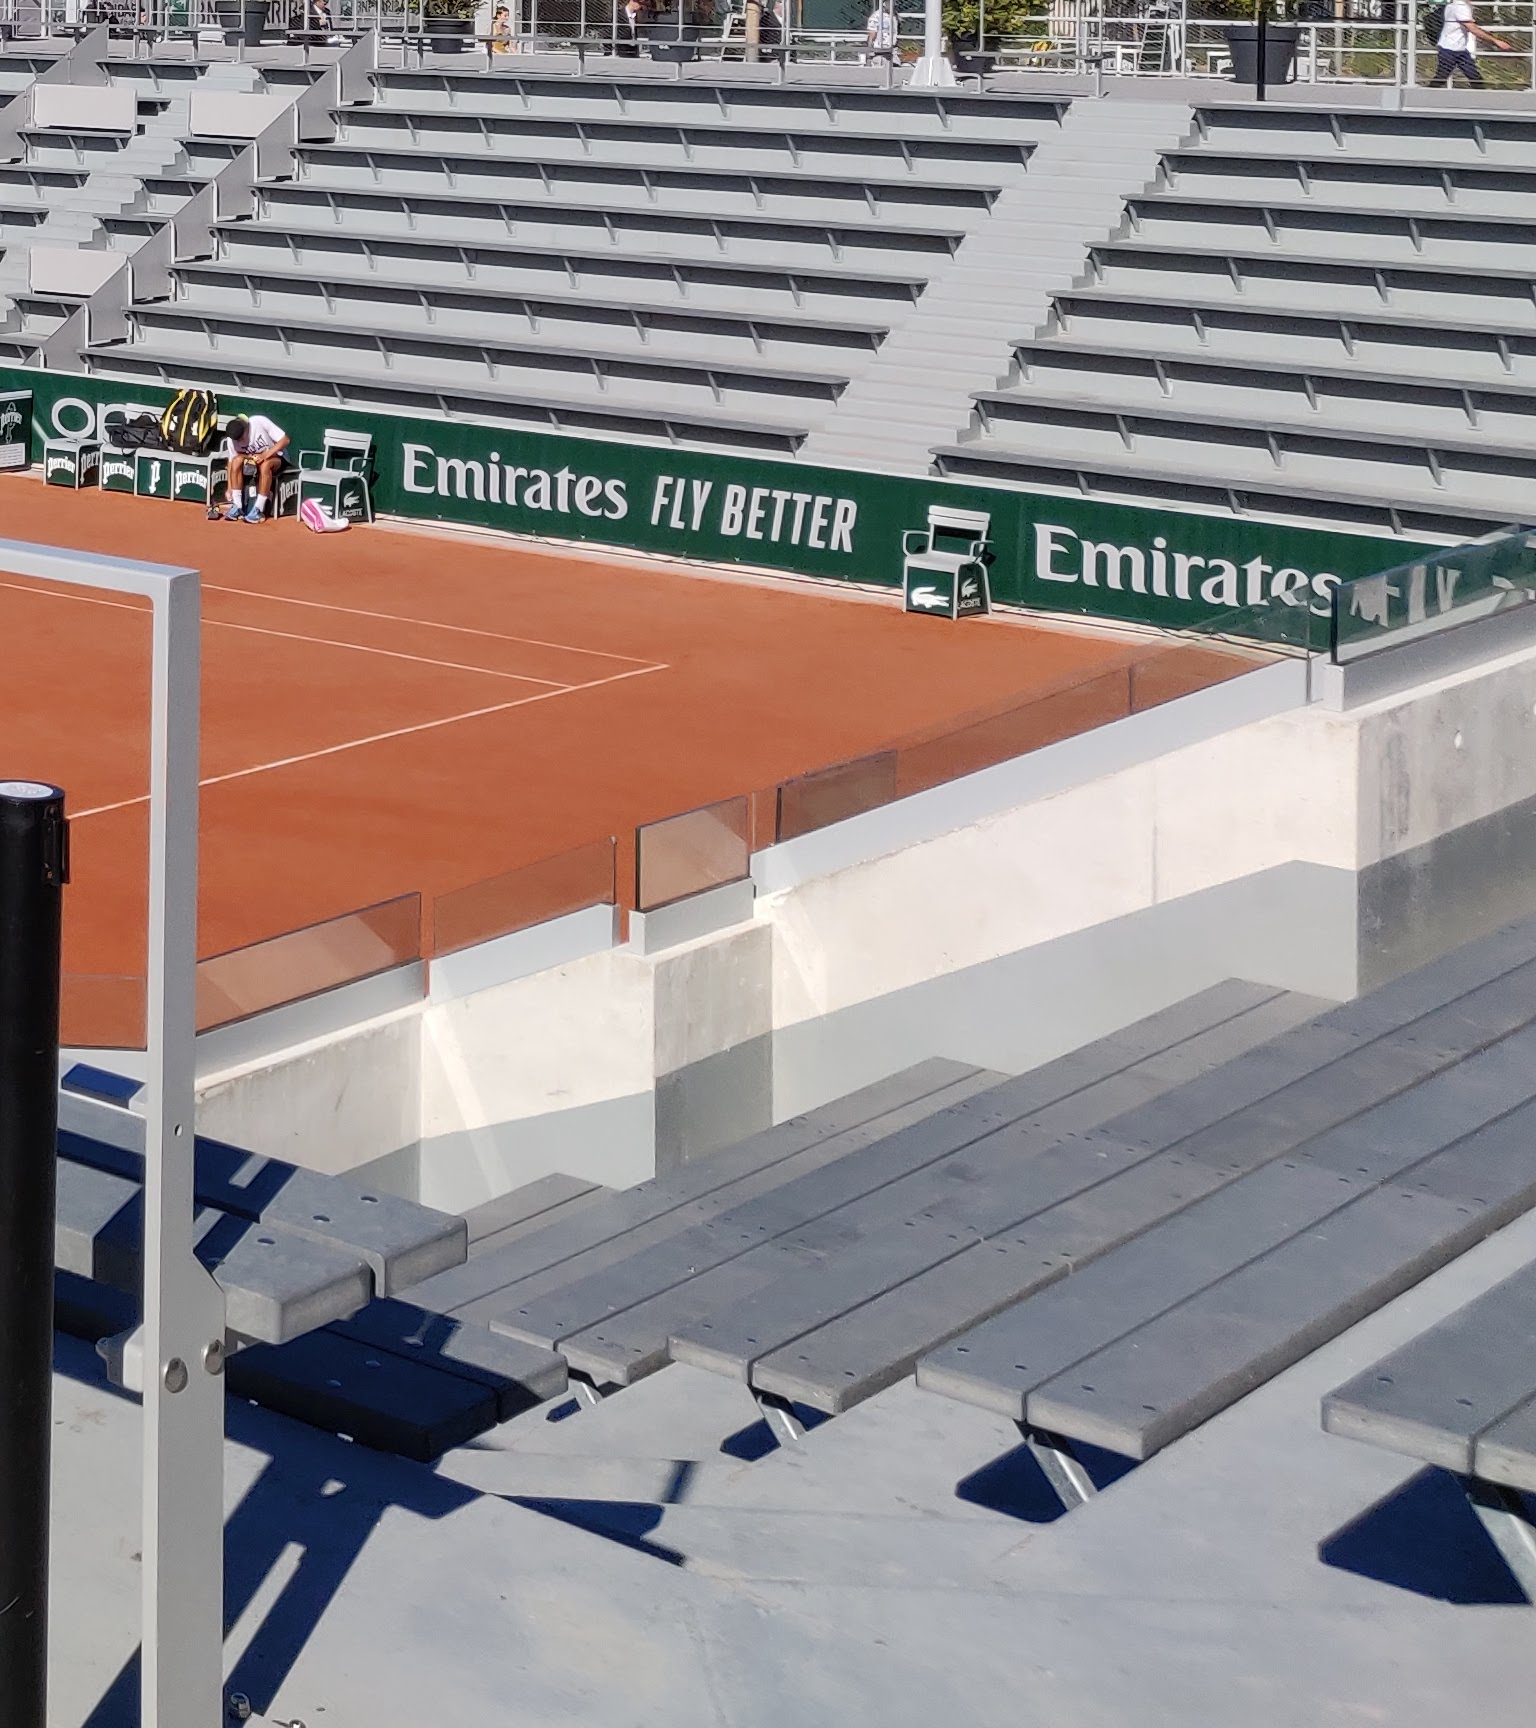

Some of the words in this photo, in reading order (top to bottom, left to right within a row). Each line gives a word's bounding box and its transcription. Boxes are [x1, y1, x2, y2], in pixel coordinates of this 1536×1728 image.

[47, 456, 76, 478] perrier
[102, 461, 134, 485] perrier
[175, 469, 208, 494] perrier
[402, 442, 629, 520] Emirates
[651, 475, 713, 532] FLY
[720, 483, 857, 553] BETTER
[1033, 522, 1342, 617] Emirates
